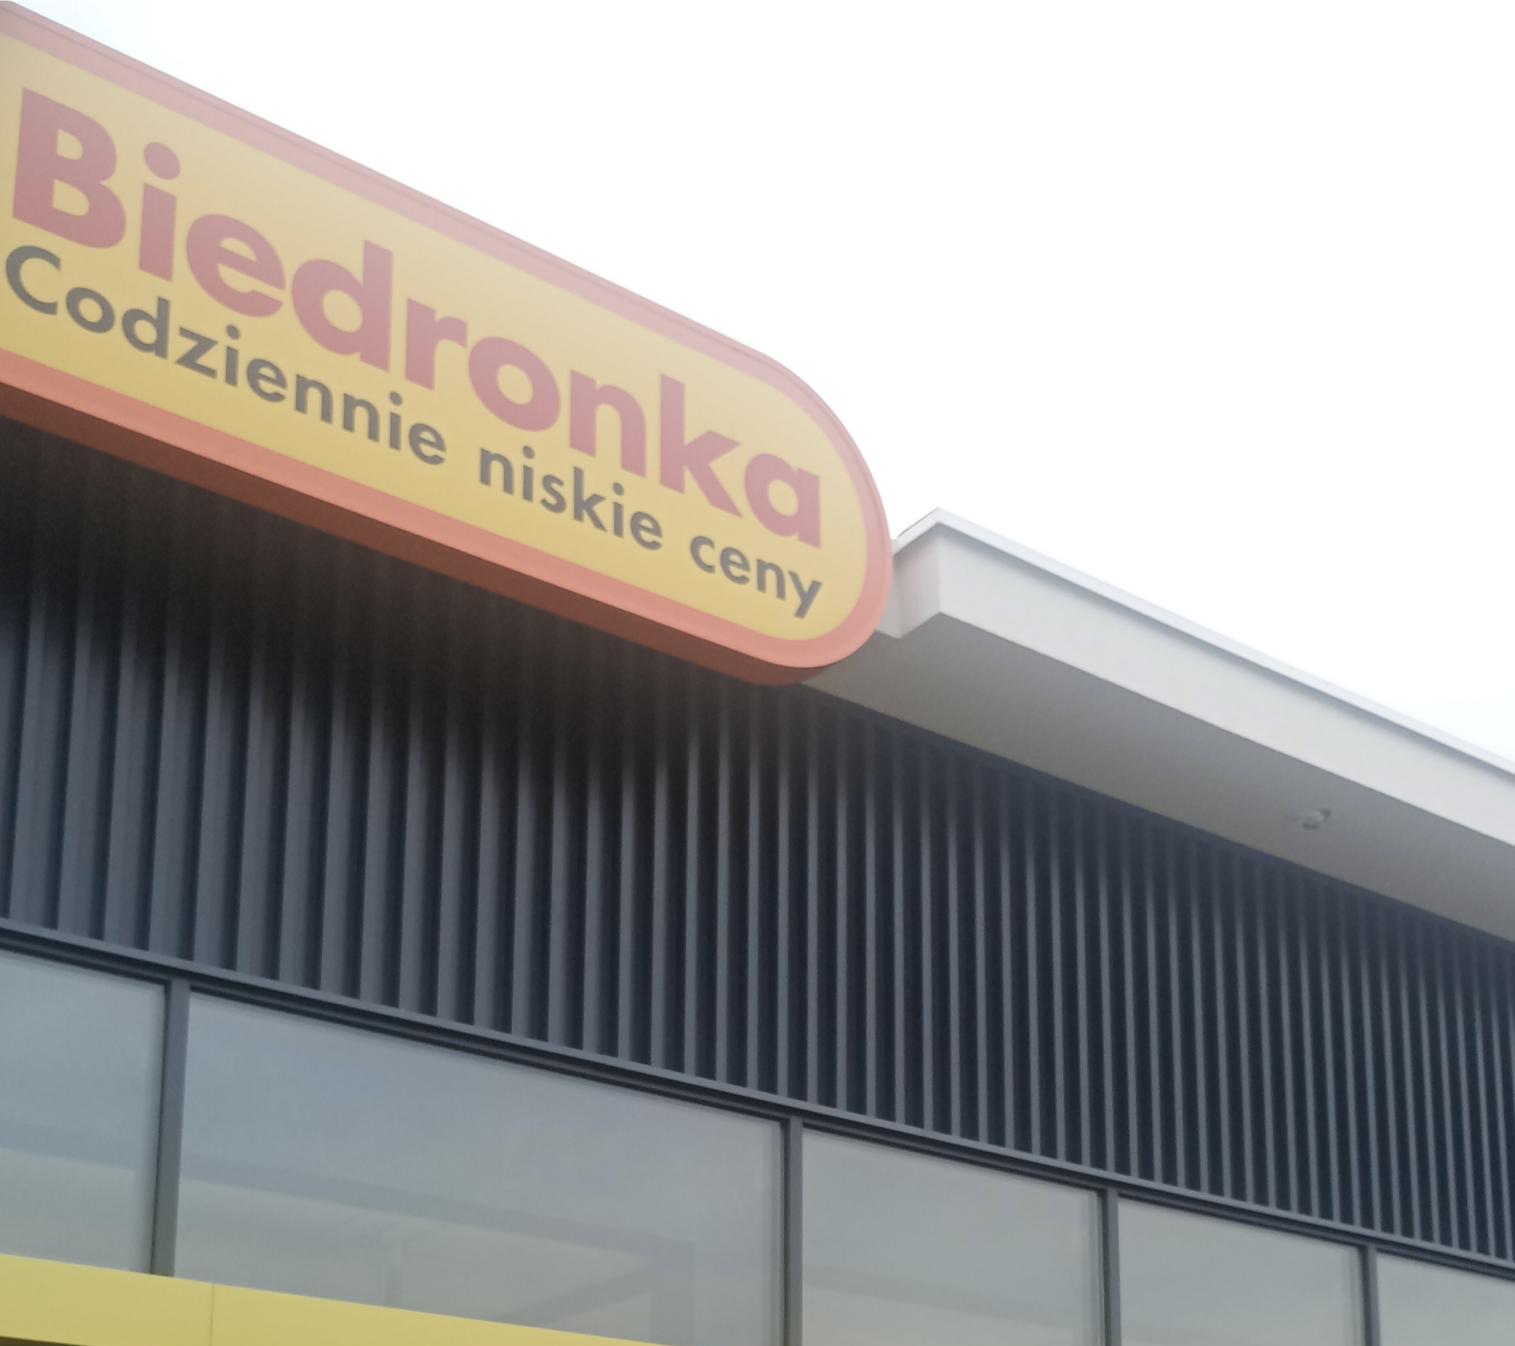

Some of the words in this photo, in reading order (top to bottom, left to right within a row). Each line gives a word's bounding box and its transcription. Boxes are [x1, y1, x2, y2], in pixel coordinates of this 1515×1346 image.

[4, 244, 447, 466] Codziennie
[479, 445, 664, 551] niskie
[689, 535, 823, 619] ceny
[12, 86, 822, 549] Biedronka
